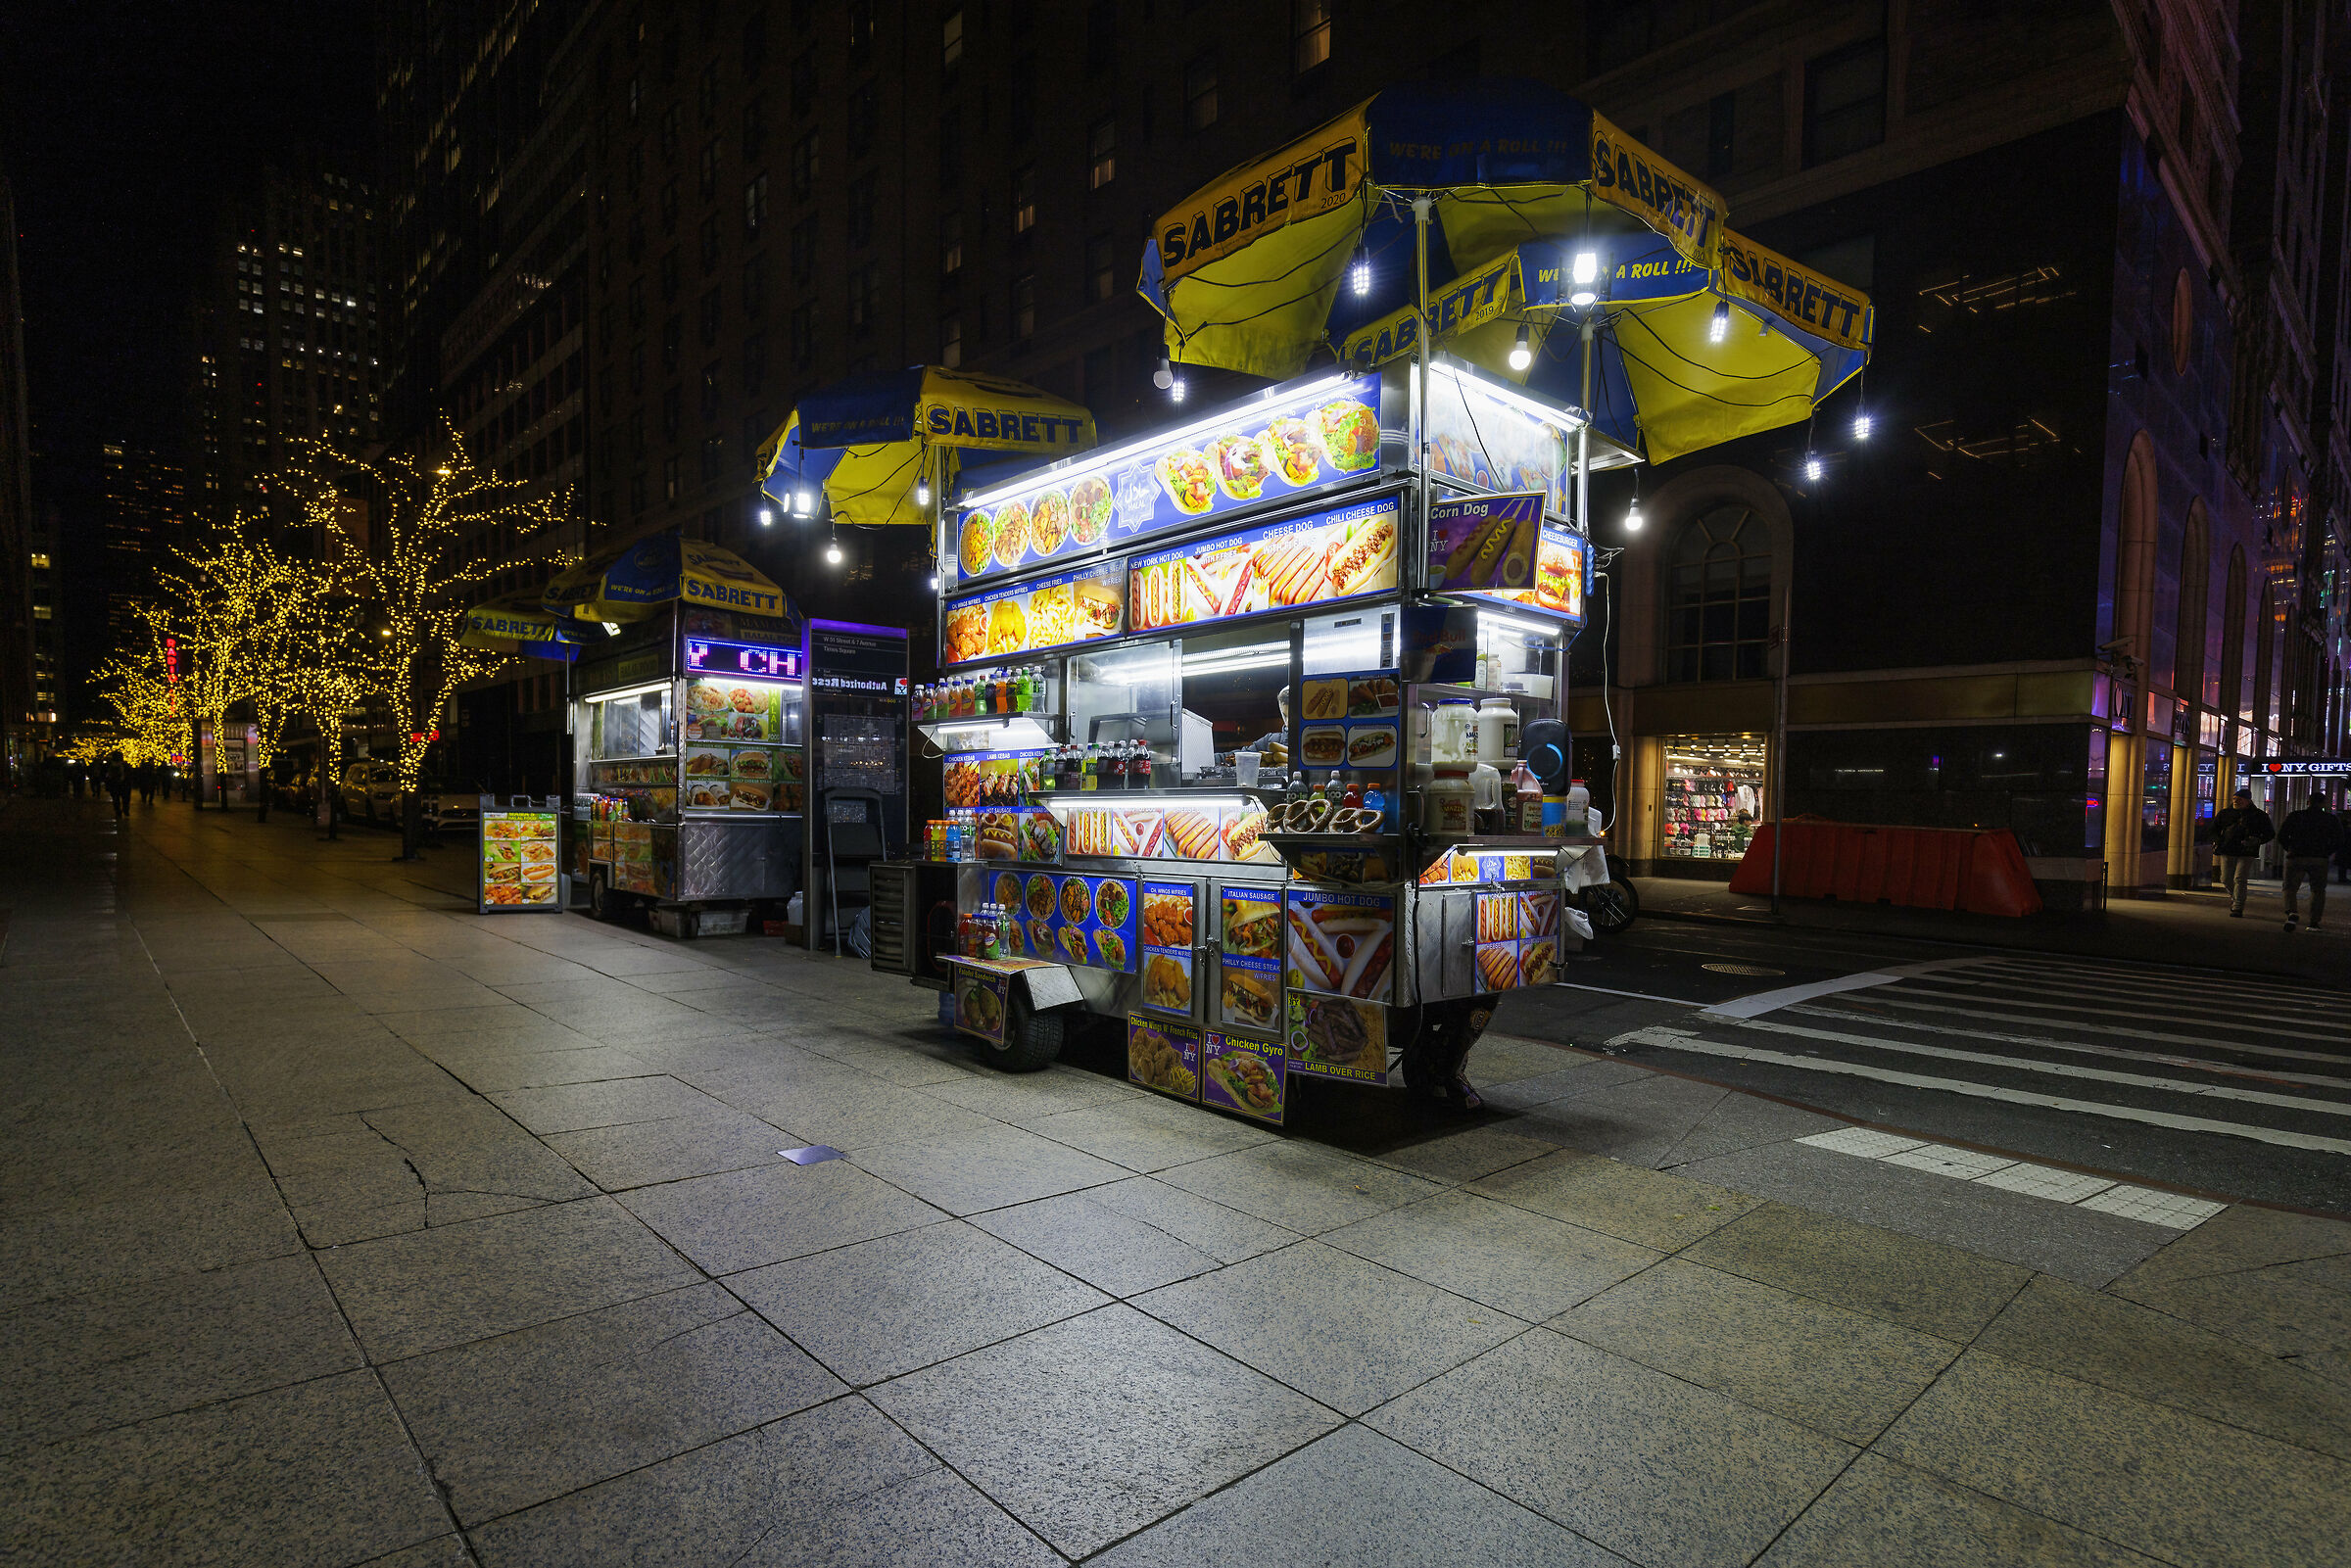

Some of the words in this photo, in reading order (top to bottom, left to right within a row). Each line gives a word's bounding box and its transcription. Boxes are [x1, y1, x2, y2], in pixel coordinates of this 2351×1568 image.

[1498, 138, 1541, 155] ROLL
[1593, 130, 1716, 248] SABRETT
[1163, 136, 1357, 268] SABRETT
[1320, 192, 1346, 209] 2020
[1631, 261, 1669, 279] ROLL
[1727, 238, 1860, 338] SABRETT
[1474, 305, 1495, 322] 2019
[926, 403, 1083, 444] SABRETT
[1325, 511, 1345, 526] CHILI
[1345, 506, 1375, 522] CHEESE
[1375, 501, 1395, 515] DOG
[1429, 505, 1460, 520] Corn
[1463, 501, 1489, 517] Dog
[1262, 525, 1294, 540] CHEESE
[1294, 520, 1314, 534] DOG
[1432, 530, 1439, 541] I
[1542, 527, 1578, 548] CHEESEBURGER
[1194, 543, 1215, 555] JUMBO
[1216, 540, 1228, 550] HOT
[1228, 537, 1243, 548] DOG
[1430, 540, 1449, 552] NY
[1130, 559, 1142, 570] NEW
[1142, 556, 1159, 568] YORK
[1159, 553, 1171, 565] HOT
[1171, 550, 1183, 562] DOG
[1073, 571, 1089, 582] PHILLY
[1089, 565, 1109, 579] CHEESE
[1036, 580, 1051, 590] CHEESE
[1051, 577, 1063, 587] FRIES
[688, 578, 779, 610] SABRETT
[1439, 629, 1466, 642] Bull
[166, 638, 178, 684] RADIO
[2280, 763, 2306, 773] NY
[2308, 762, 2351, 773] GIFTS
[1227, 890, 1248, 899] ITALIAN
[1249, 891, 1275, 901] SAUSAGE
[1303, 891, 1335, 904] JUMBO
[1337, 894, 1357, 906] HOT
[1359, 895, 1380, 907] DOG
[1223, 958, 1240, 967] PHILLY
[1240, 960, 1262, 970] CHEESE
[1263, 963, 1280, 972] STEAK
[1129, 1016, 1148, 1028] Chicken
[1148, 1021, 1163, 1033] Wings
[1170, 1024, 1186, 1036] French
[1186, 1029, 1198, 1040] Fries
[1208, 1033, 1213, 1044] I
[1225, 1034, 1260, 1052] Chicken
[1262, 1043, 1283, 1058] Gyro
[1183, 1051, 1196, 1062] NY
[1205, 1043, 1222, 1056] NY
[1304, 1062, 1328, 1074] LAMB
[1329, 1066, 1353, 1078] OVER
[1355, 1069, 1376, 1081] RICE
